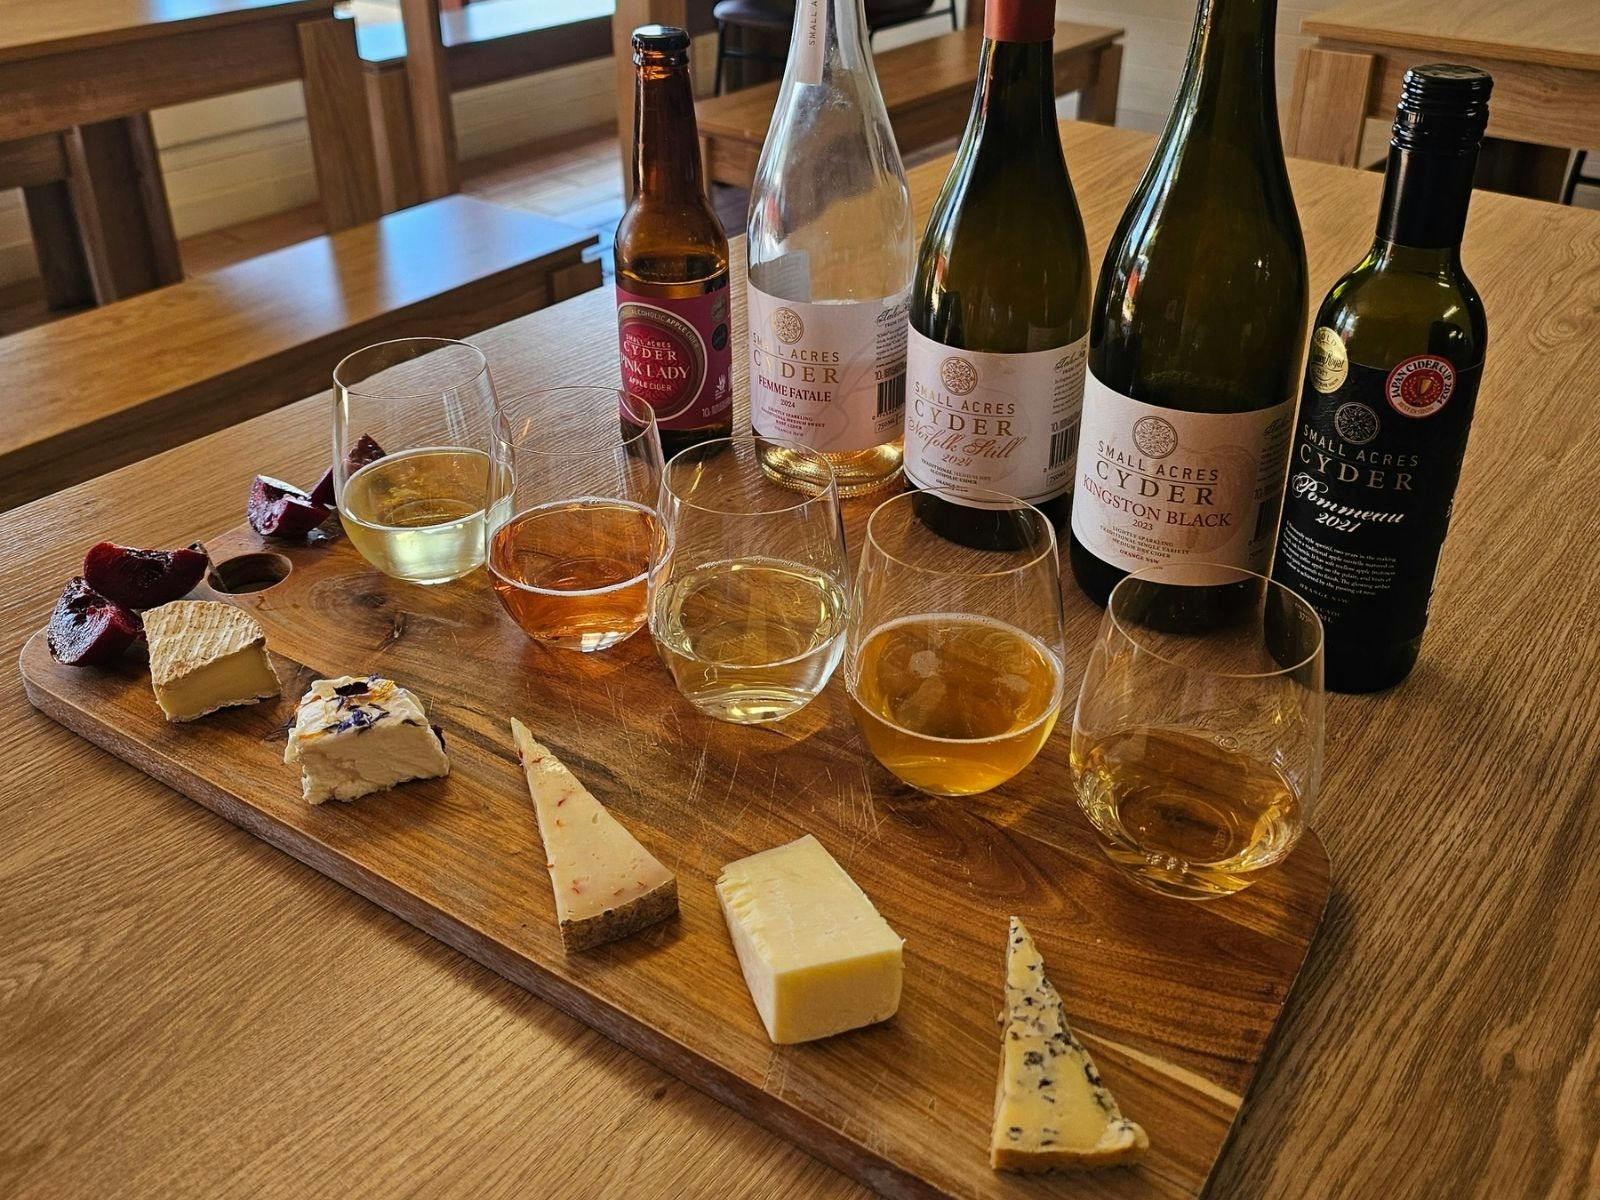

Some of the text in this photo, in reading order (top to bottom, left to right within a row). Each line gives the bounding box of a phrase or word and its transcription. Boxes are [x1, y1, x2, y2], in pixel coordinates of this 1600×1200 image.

[809, 11, 817, 46] SMALL
[666, 318, 687, 333] APPLE
[623, 340, 677, 361] CYDER
[625, 333, 672, 349] SMALL ACRES
[753, 349, 840, 384] CYDER
[790, 349, 840, 363] ACRES
[629, 376, 673, 392] APPLE CIDER
[646, 364, 690, 379] LADY
[1391, 360, 1452, 405] JAPAN CIDER CUP 2024
[758, 374, 832, 402] FEMME FATALE
[914, 381, 1015, 415] SMALL ACRES
[780, 398, 796, 408] 2024
[914, 399, 1013, 438] CYDER
[908, 416, 1027, 459] Norfolk Still
[1303, 424, 1347, 457] SMALL
[1355, 449, 1419, 467] ACRES
[1098, 440, 1218, 481] SMALL ACRES
[1300, 443, 1413, 491] CYDER
[1096, 460, 1214, 506] CYDER
[1083, 474, 1232, 528] KINGSTON BLACK
[1291, 470, 1406, 525] Pommeau
[1112, 525, 1174, 548] LIGHTLY SPARKLING
[1132, 519, 1153, 531] 2023
[1314, 512, 1361, 534] 2021
[1100, 525, 1136, 545] TRADITIONAL
[1137, 541, 1161, 551] SINGLE
[1112, 537, 1136, 551] MEDIUM
[1150, 550, 1171, 559] CIDER
[1119, 548, 1161, 565] ORANGE NSW
